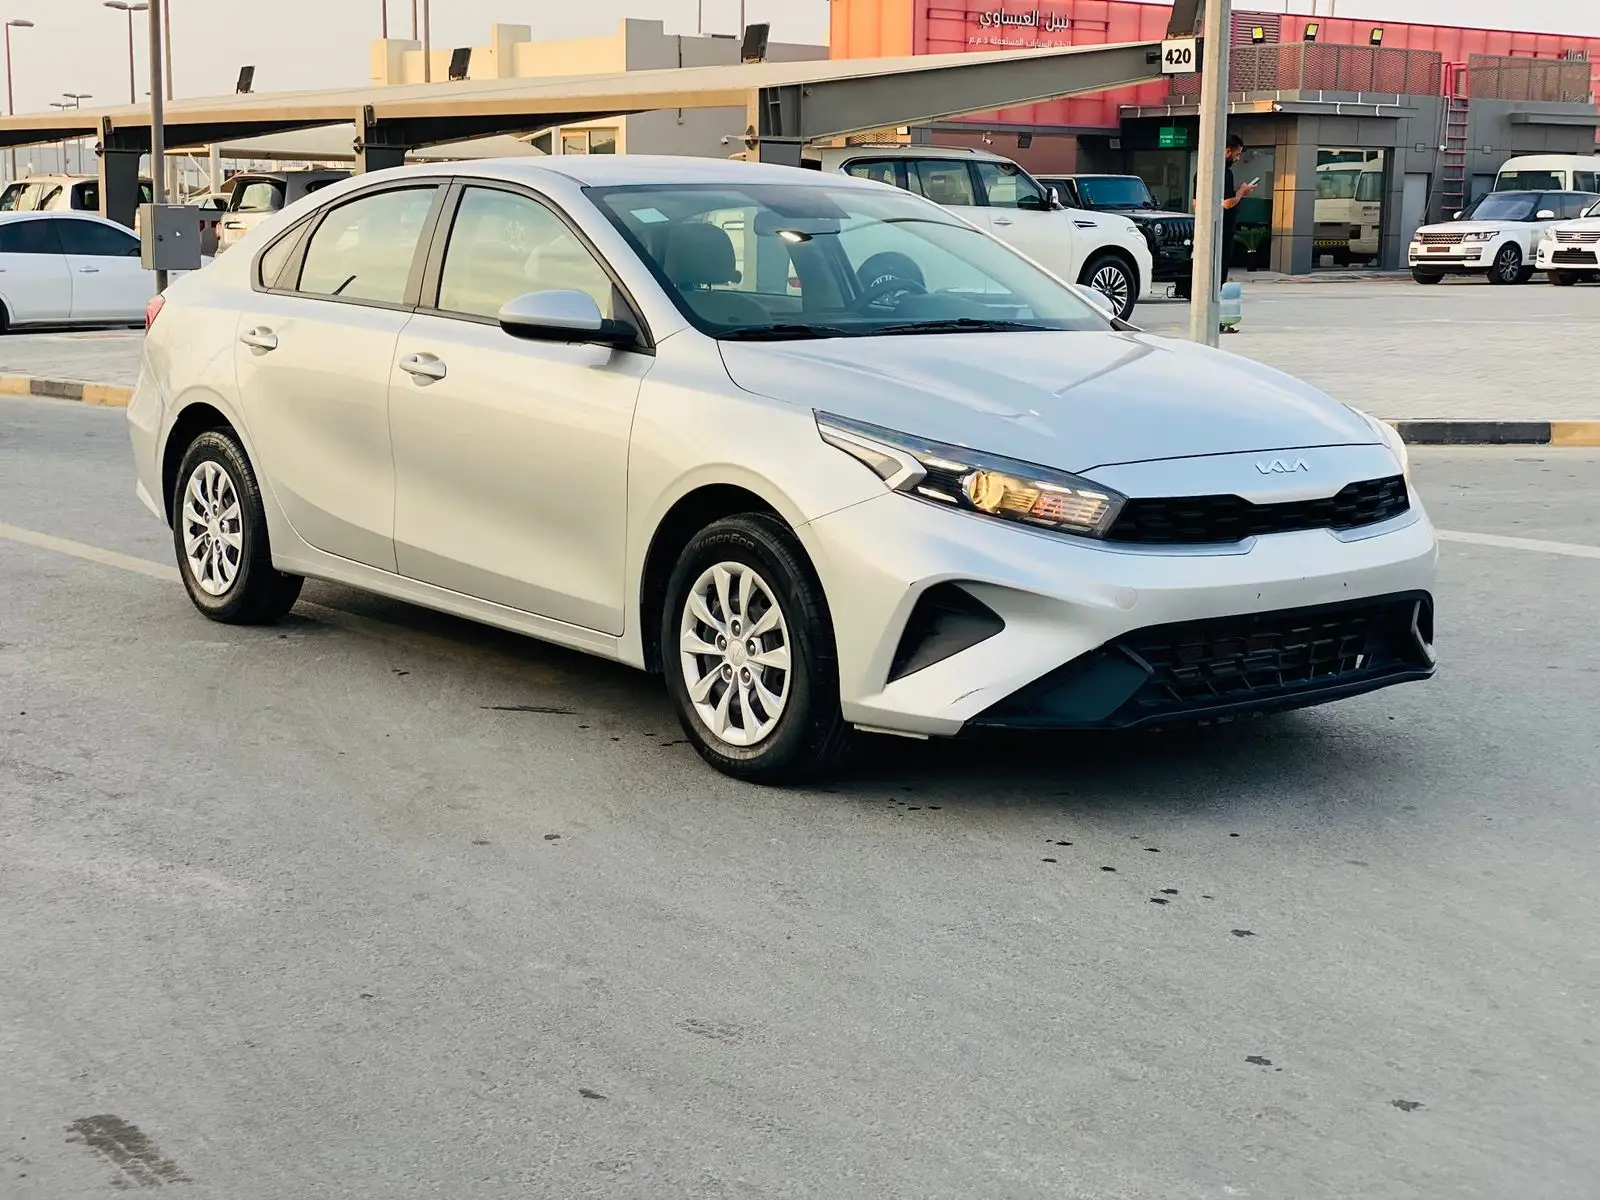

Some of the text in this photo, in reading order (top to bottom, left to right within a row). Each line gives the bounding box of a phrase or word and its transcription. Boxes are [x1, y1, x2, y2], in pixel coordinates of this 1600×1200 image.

[979, 7, 1069, 32] نبيل العيساوي
[989, 36, 1024, 46] المستعملة
[1164, 48, 1192, 65] 420
[1254, 458, 1312, 475] KIA
